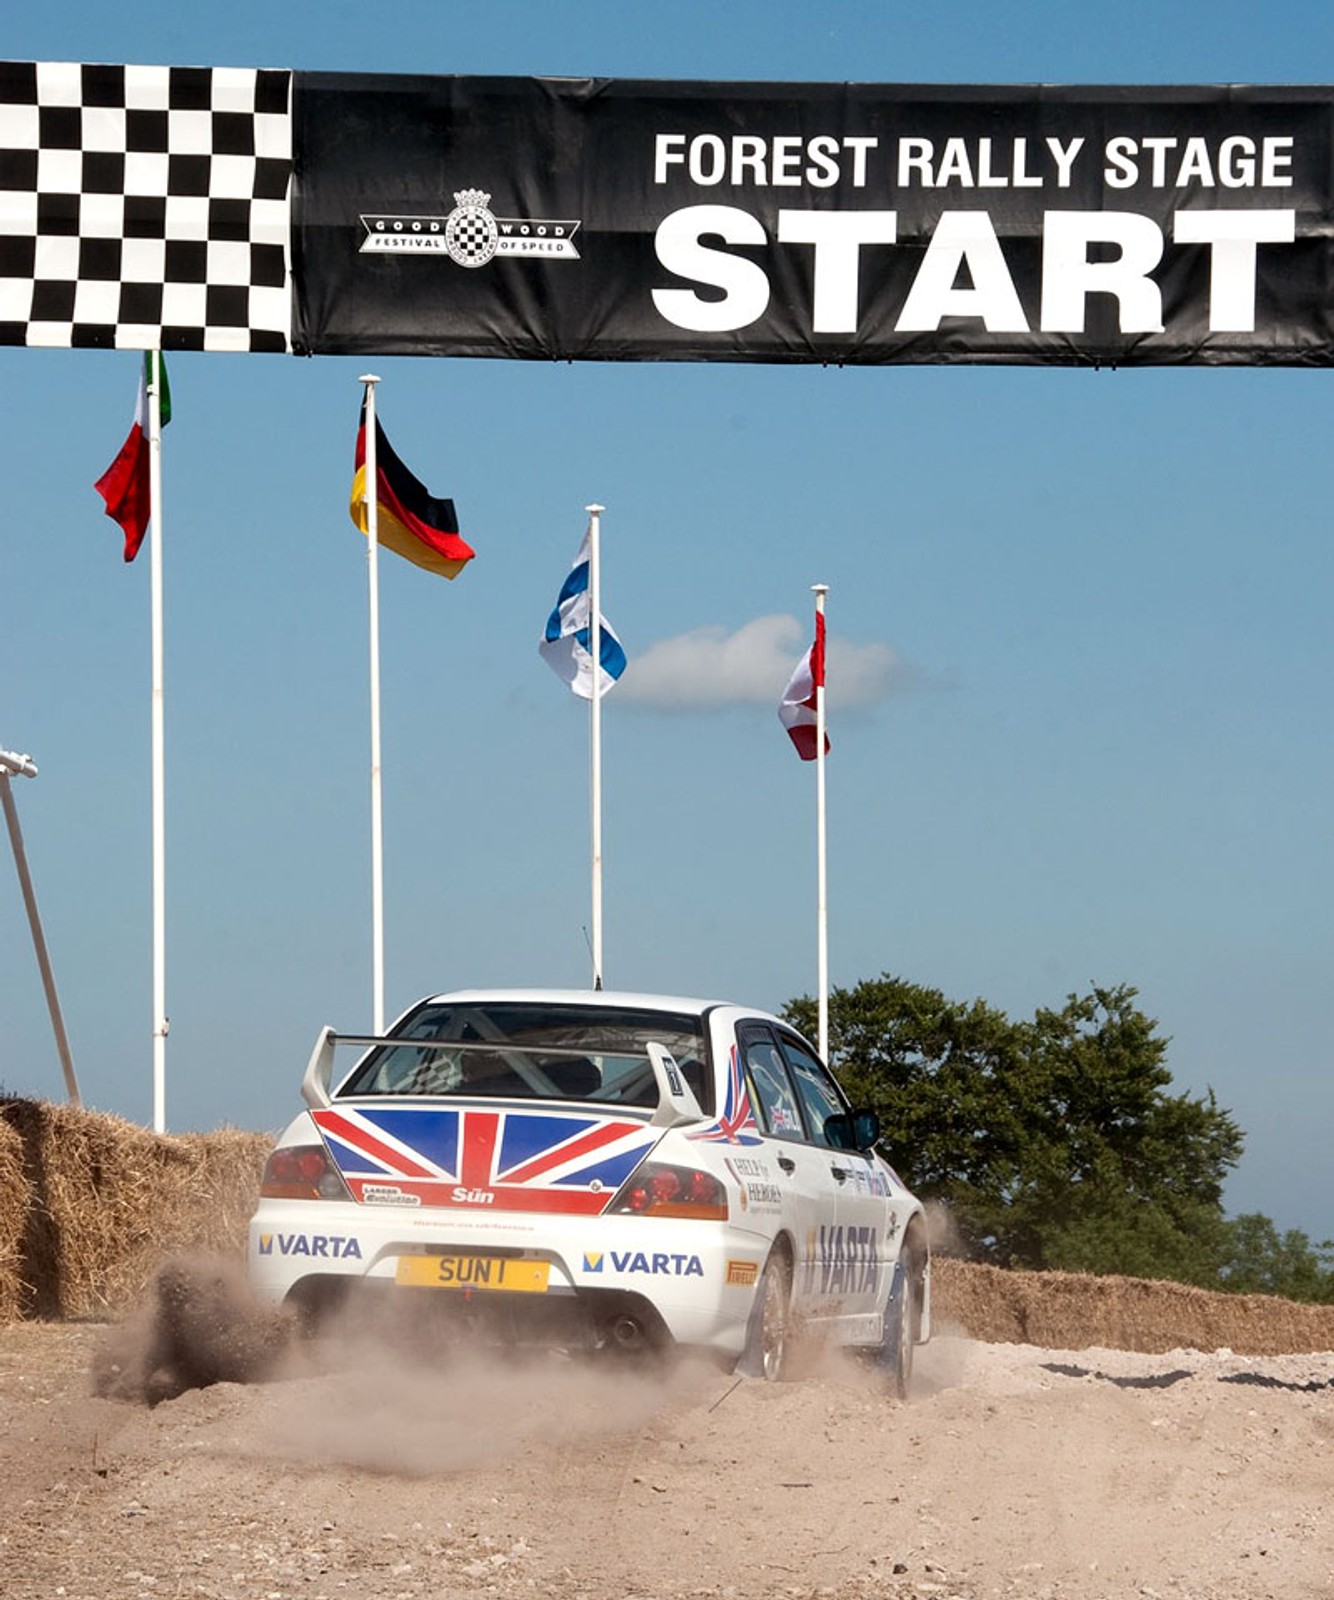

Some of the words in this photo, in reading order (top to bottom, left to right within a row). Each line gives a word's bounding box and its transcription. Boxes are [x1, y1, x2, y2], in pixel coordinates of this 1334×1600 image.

[654, 134, 878, 188] FOREST
[897, 136, 1085, 188] RALLY
[1104, 136, 1294, 190] STAGE
[375, 220, 440, 232] GOOD
[501, 223, 565, 237] WOOD
[375, 238, 440, 248] FESTIVAL
[501, 241, 516, 250] OF
[521, 242, 564, 252] SPEED
[651, 204, 1296, 333] START
[278, 1234, 363, 1260] VARTA
[820, 1225, 878, 1294] VARTA
[610, 1251, 704, 1277] VARTA
